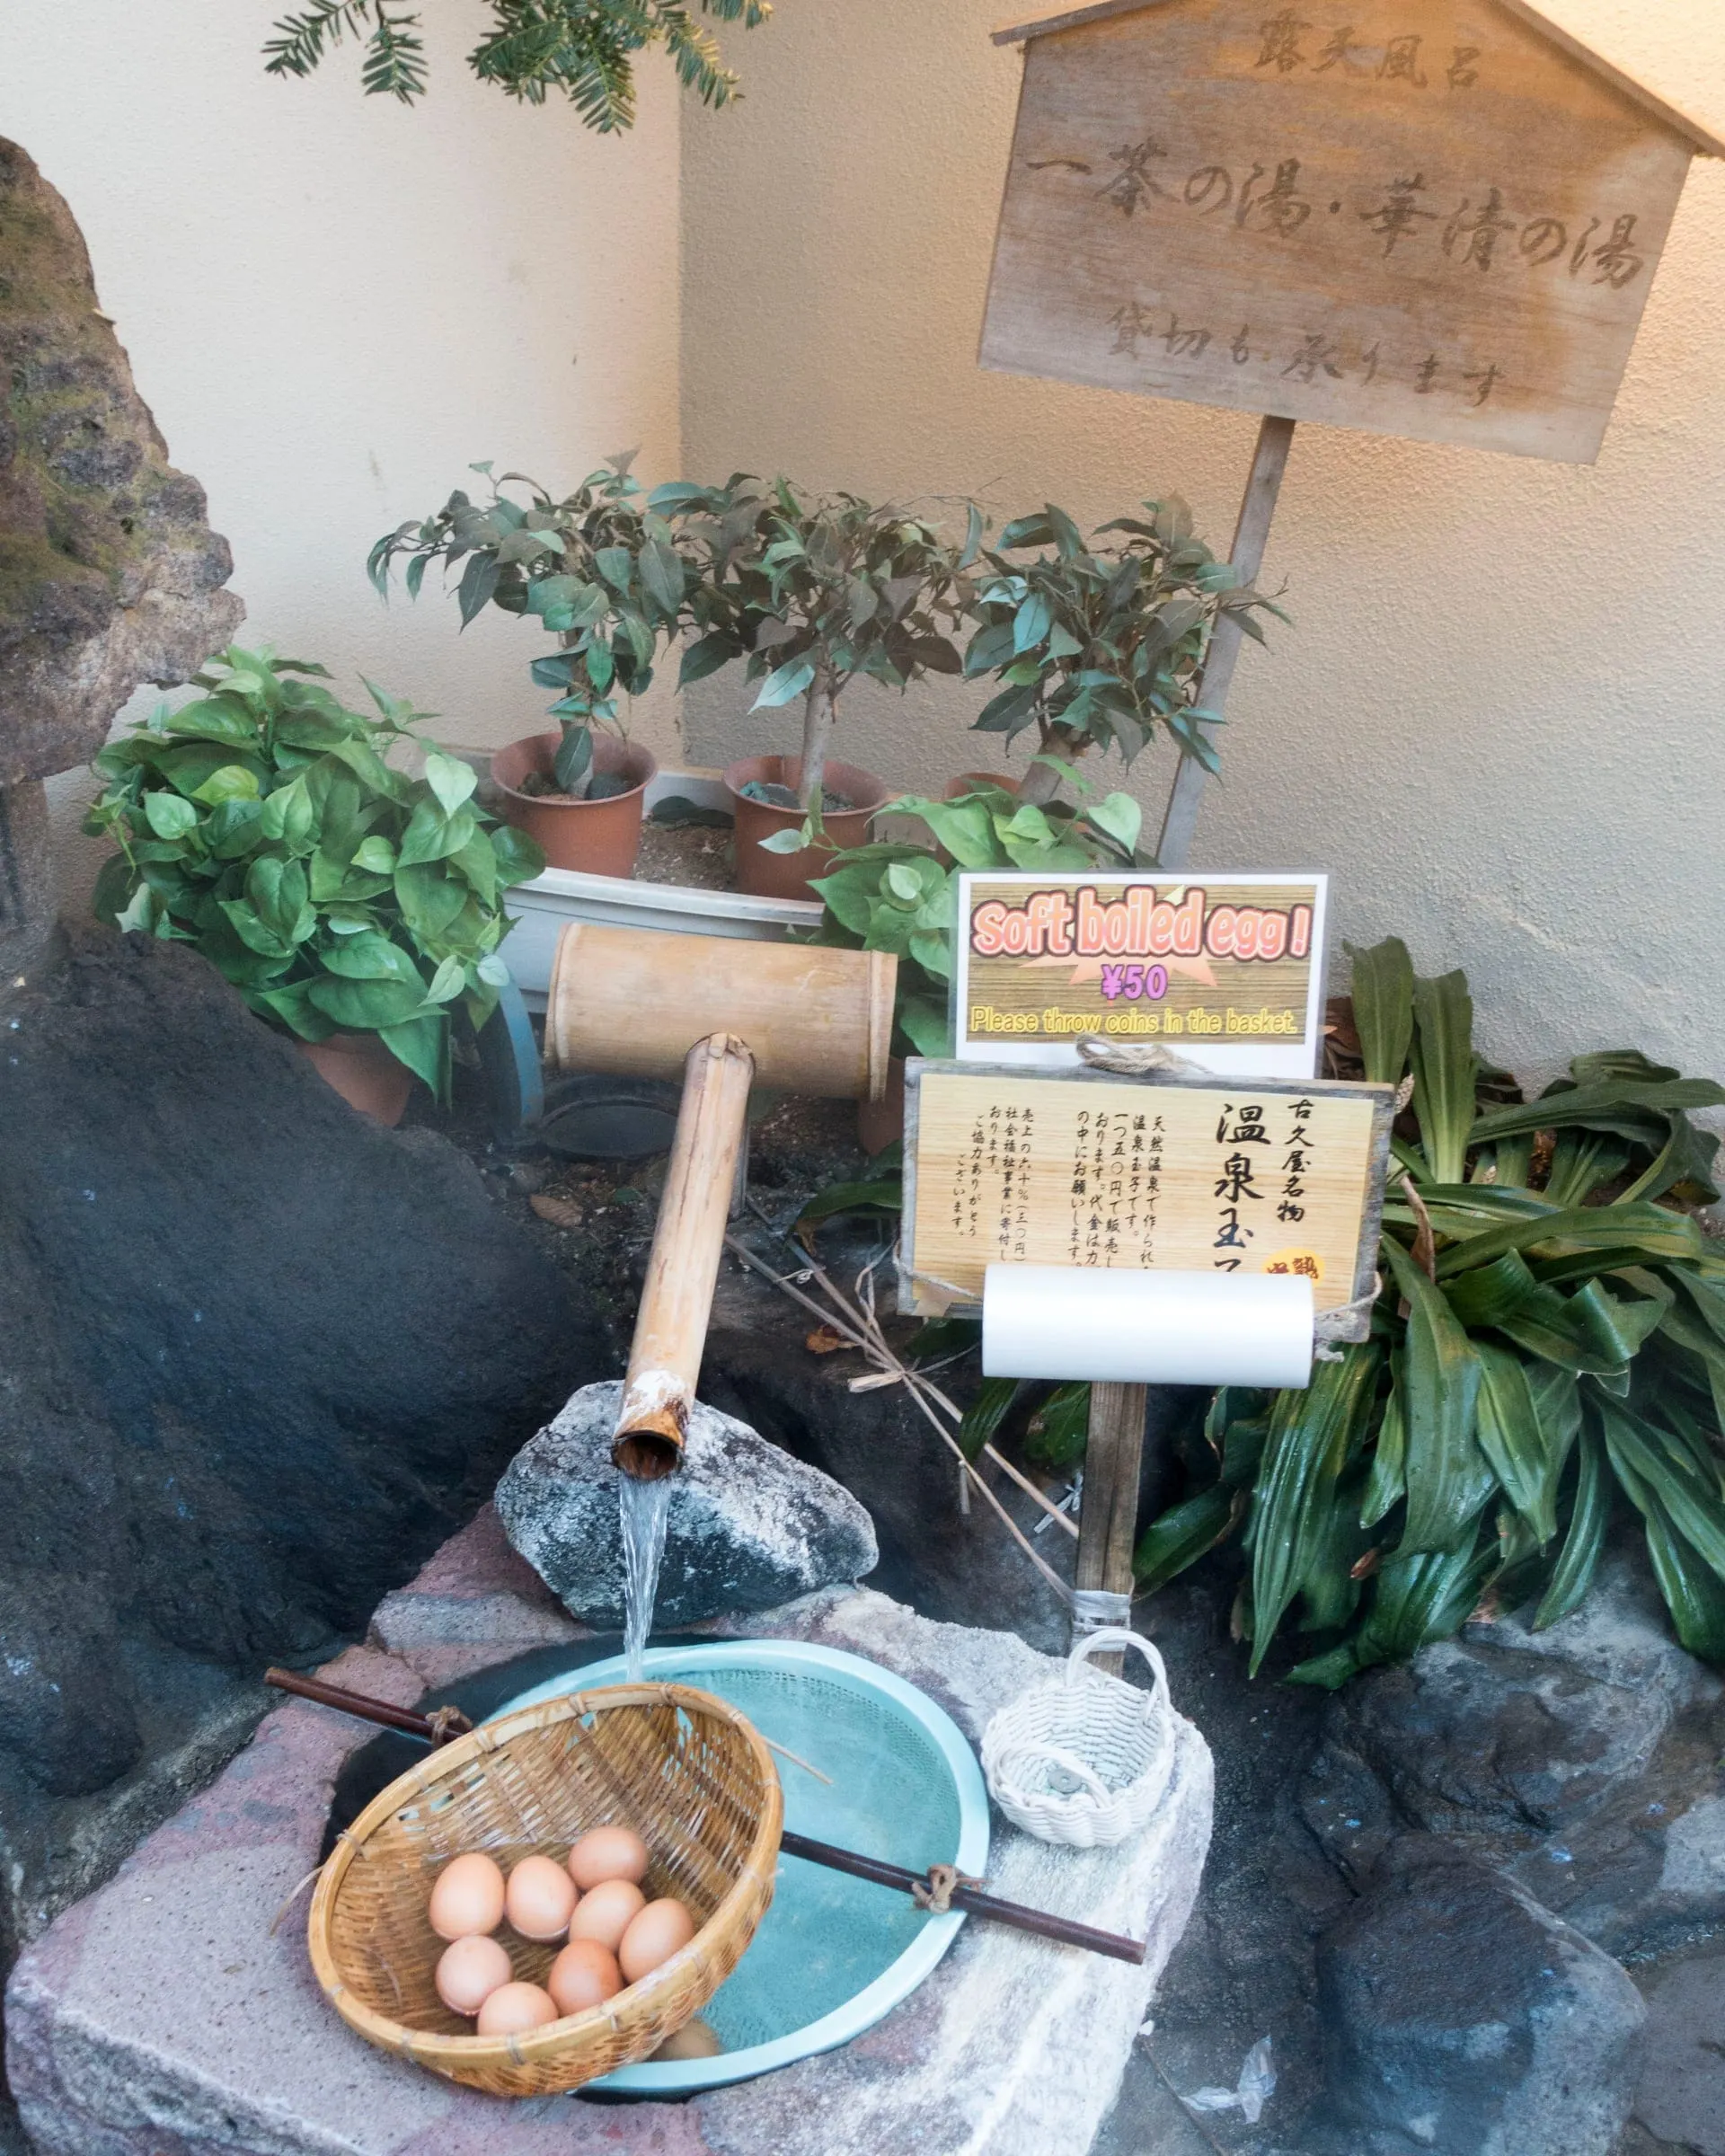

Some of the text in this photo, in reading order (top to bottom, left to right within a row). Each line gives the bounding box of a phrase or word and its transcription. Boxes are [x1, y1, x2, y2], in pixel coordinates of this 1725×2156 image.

[970, 889, 1074, 956] Soft
[1075, 884, 1208, 958] boiled
[1101, 964, 1168, 1001] ¥50
[970, 1006, 1298, 1035] Please throw coins in the basket.
[1277, 1099, 1315, 1223] 古久屋名物
